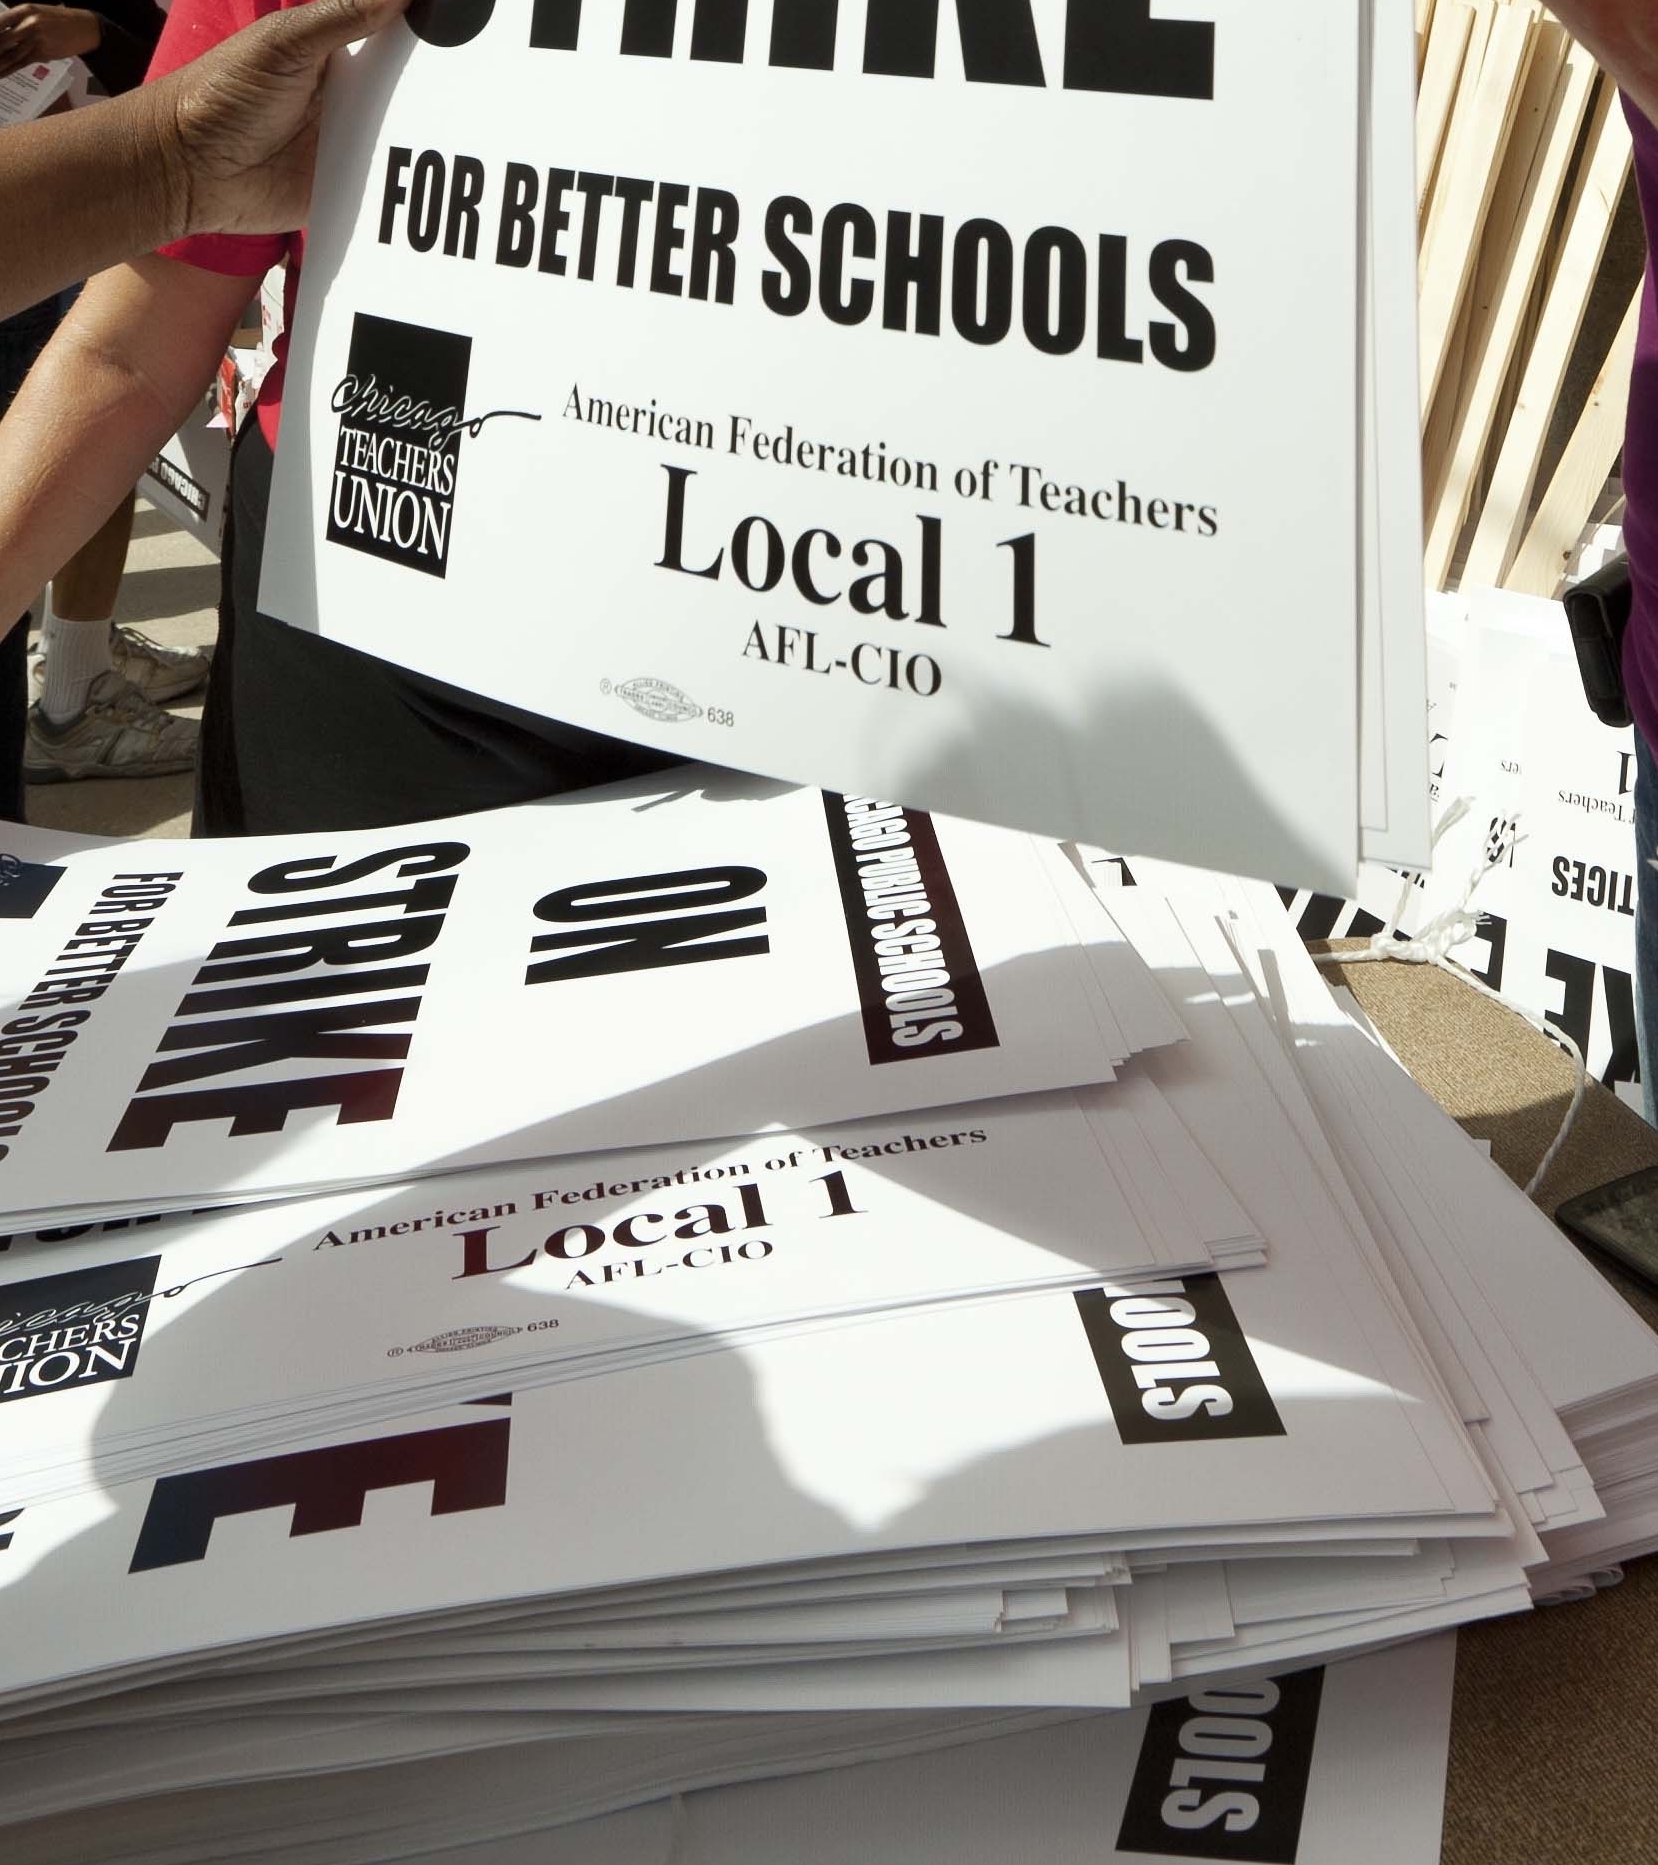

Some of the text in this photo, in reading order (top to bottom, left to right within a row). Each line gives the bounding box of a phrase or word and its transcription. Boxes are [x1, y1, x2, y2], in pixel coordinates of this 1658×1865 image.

[376, 144, 1217, 373] FOR BETTER SCHOOLS
[331, 373, 517, 452] Chicago
[160, 462, 207, 512] CHICAGO
[339, 425, 455, 496] TEACHERS
[562, 382, 1220, 538] American Federation of Teachers
[332, 469, 451, 561] UNION
[652, 462, 1055, 649] Local 1
[741, 619, 944, 700] AFL-CIO
[707, 706, 734, 728] 638
[88, 871, 184, 915] FOR
[523, 865, 770, 986] ON
[855, 846, 932, 920] PUBLIC
[18, 917, 155, 1011] BETTER
[105, 841, 471, 1153] STRIKE
[870, 918, 964, 1048] SCHOOLS
[312, 1126, 988, 1252] American Federation of Teachers
[451, 1169, 869, 1281] Local 1
[563, 1237, 774, 1291] AFL-CIO
[527, 1318, 560, 1333] 638
